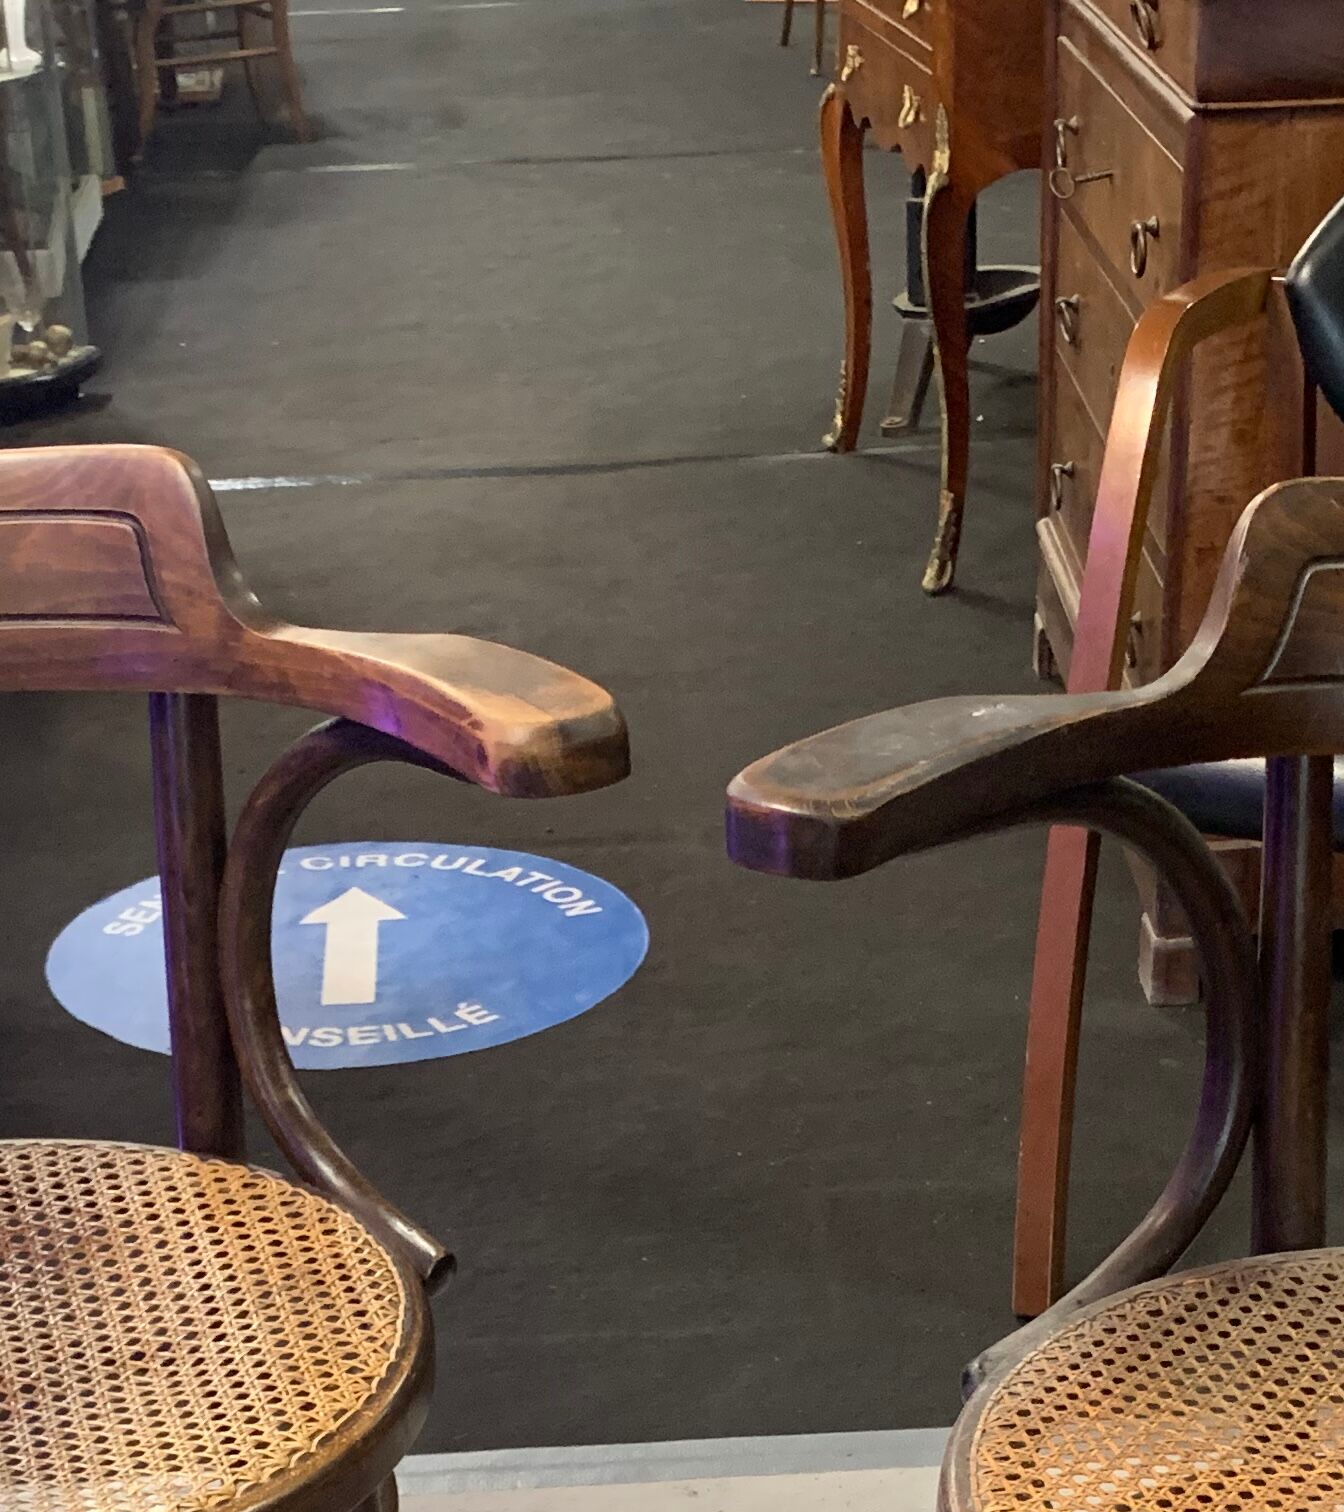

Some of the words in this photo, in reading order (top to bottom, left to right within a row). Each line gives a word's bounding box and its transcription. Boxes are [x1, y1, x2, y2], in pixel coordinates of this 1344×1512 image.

[102, 893, 163, 936] SEN
[299, 852, 603, 919] CIRCULATION
[280, 1002, 501, 1048] NSEILLÉ
